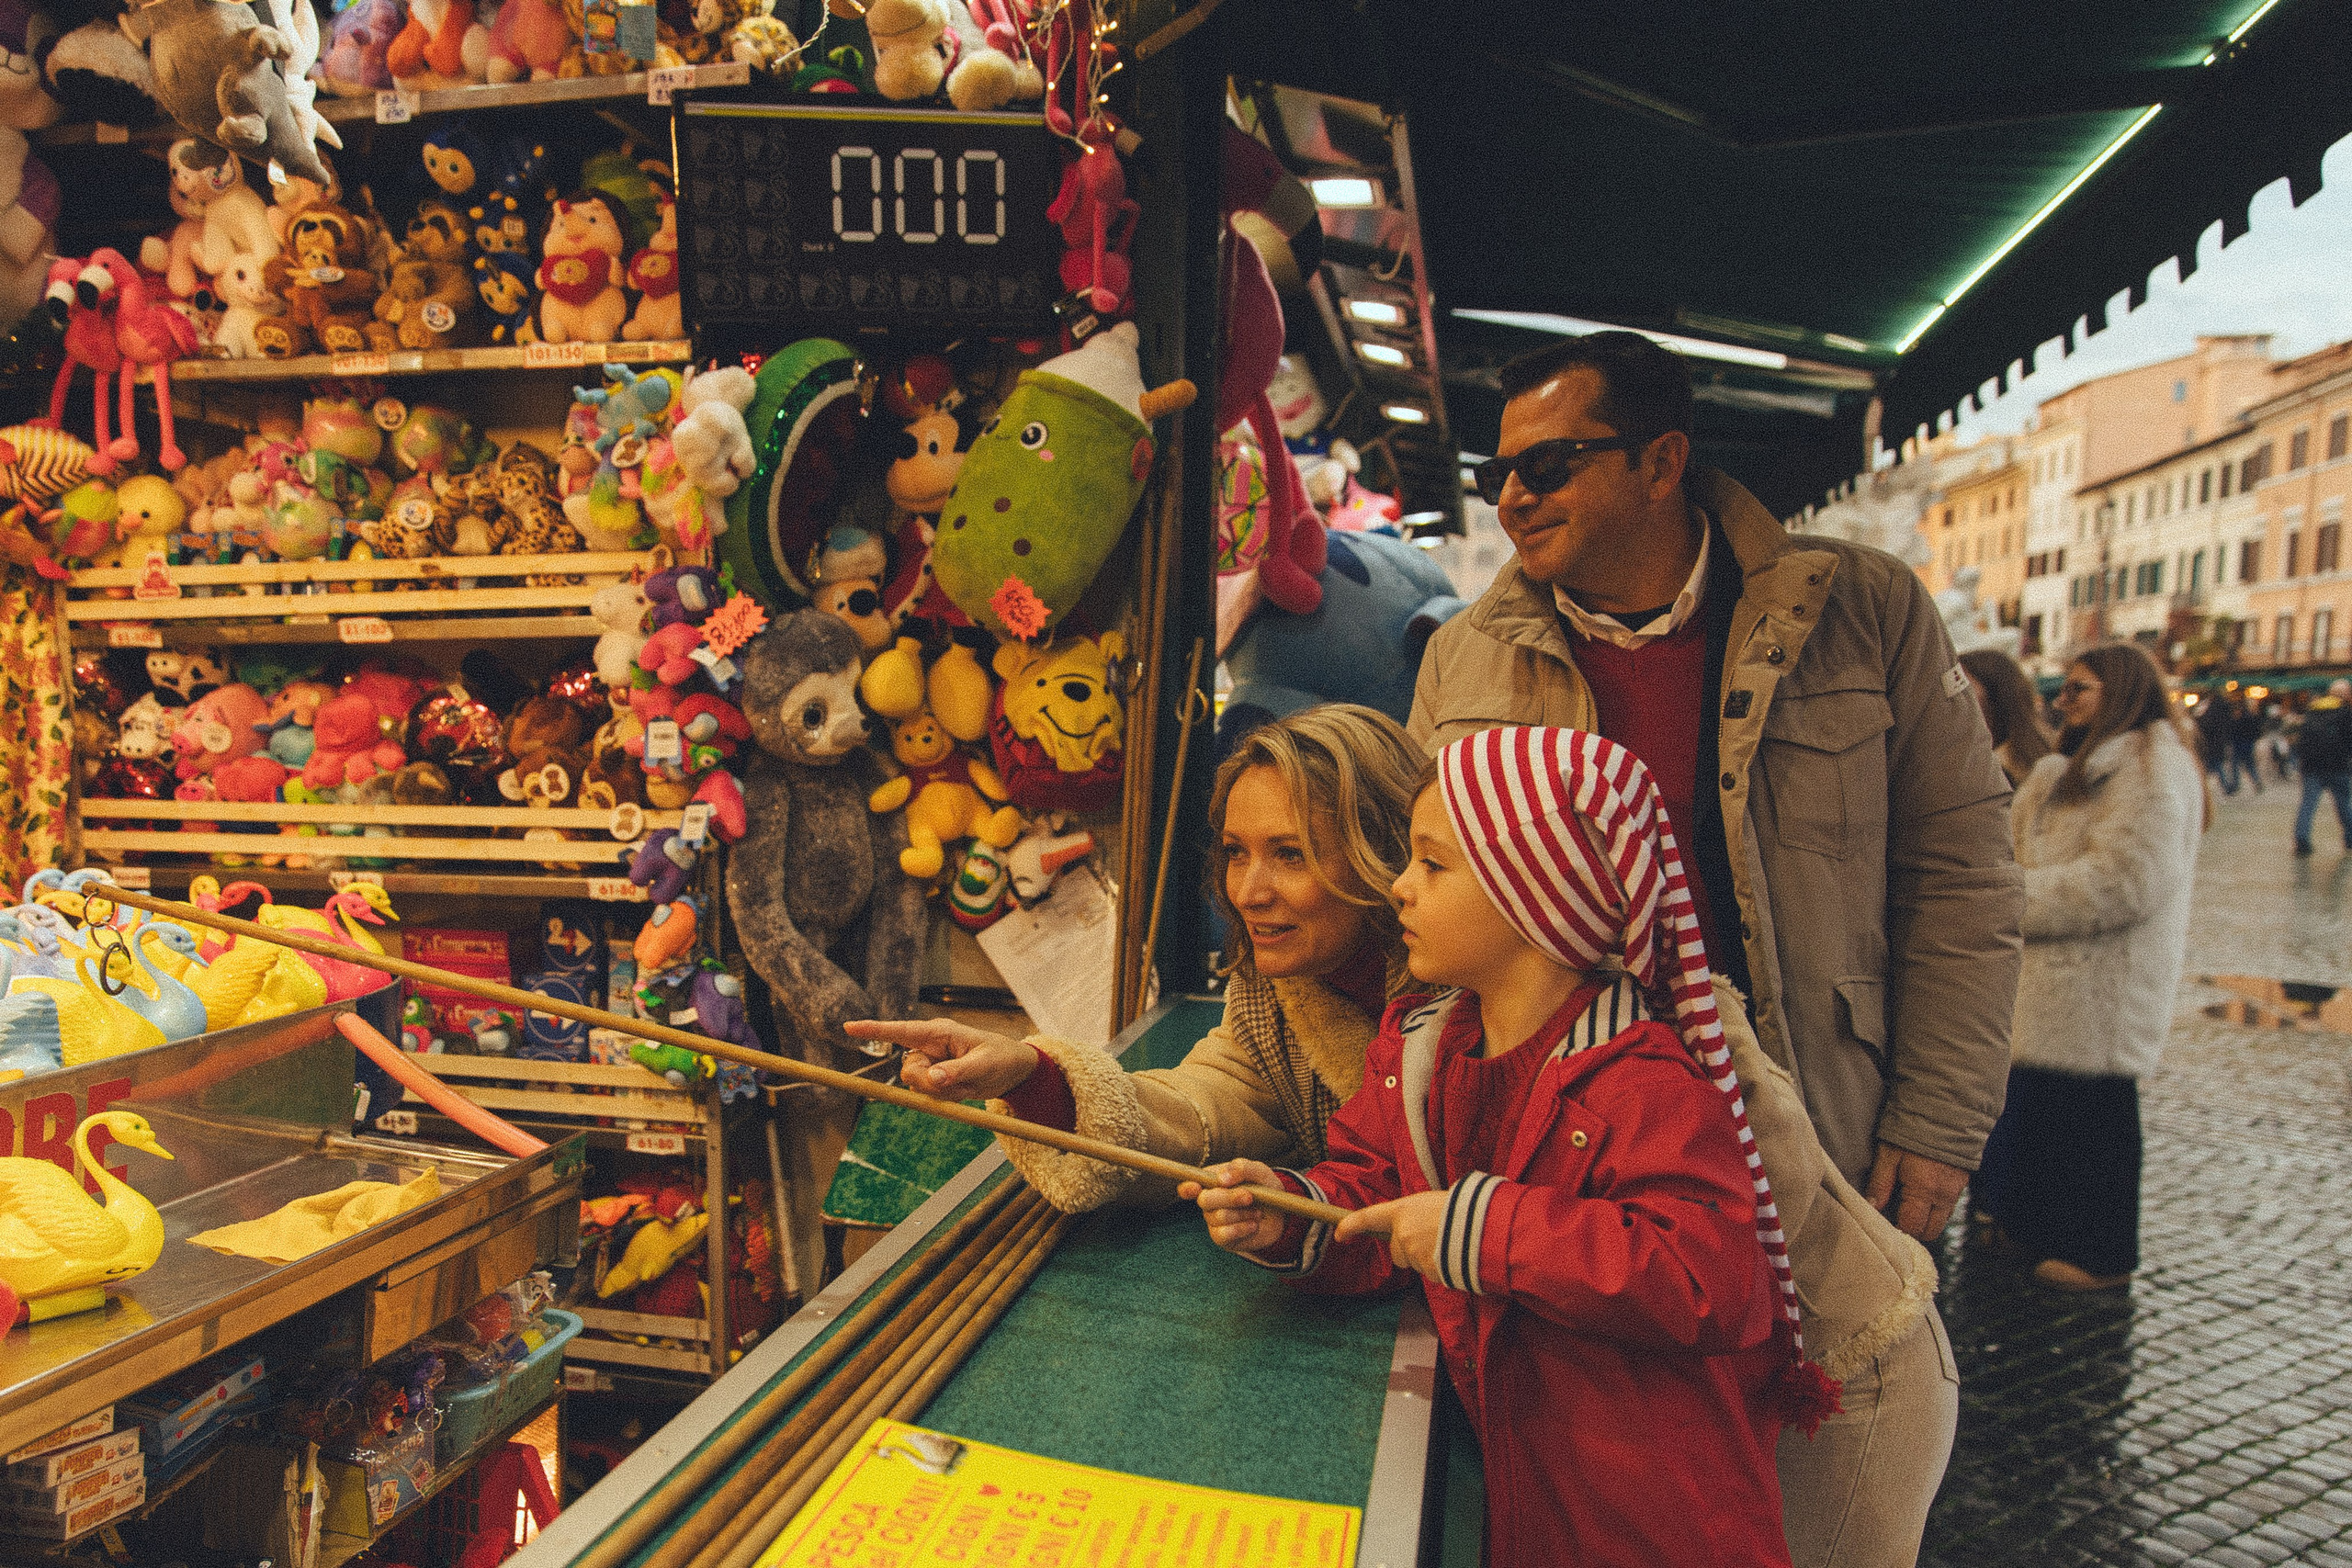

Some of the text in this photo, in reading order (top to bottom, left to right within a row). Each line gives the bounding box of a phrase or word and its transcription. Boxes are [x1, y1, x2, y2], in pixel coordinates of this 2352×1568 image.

[831, 145, 1006, 245] 000
[0, 1077, 131, 1194] RE
[934, 1503, 994, 1562] CIGNI
